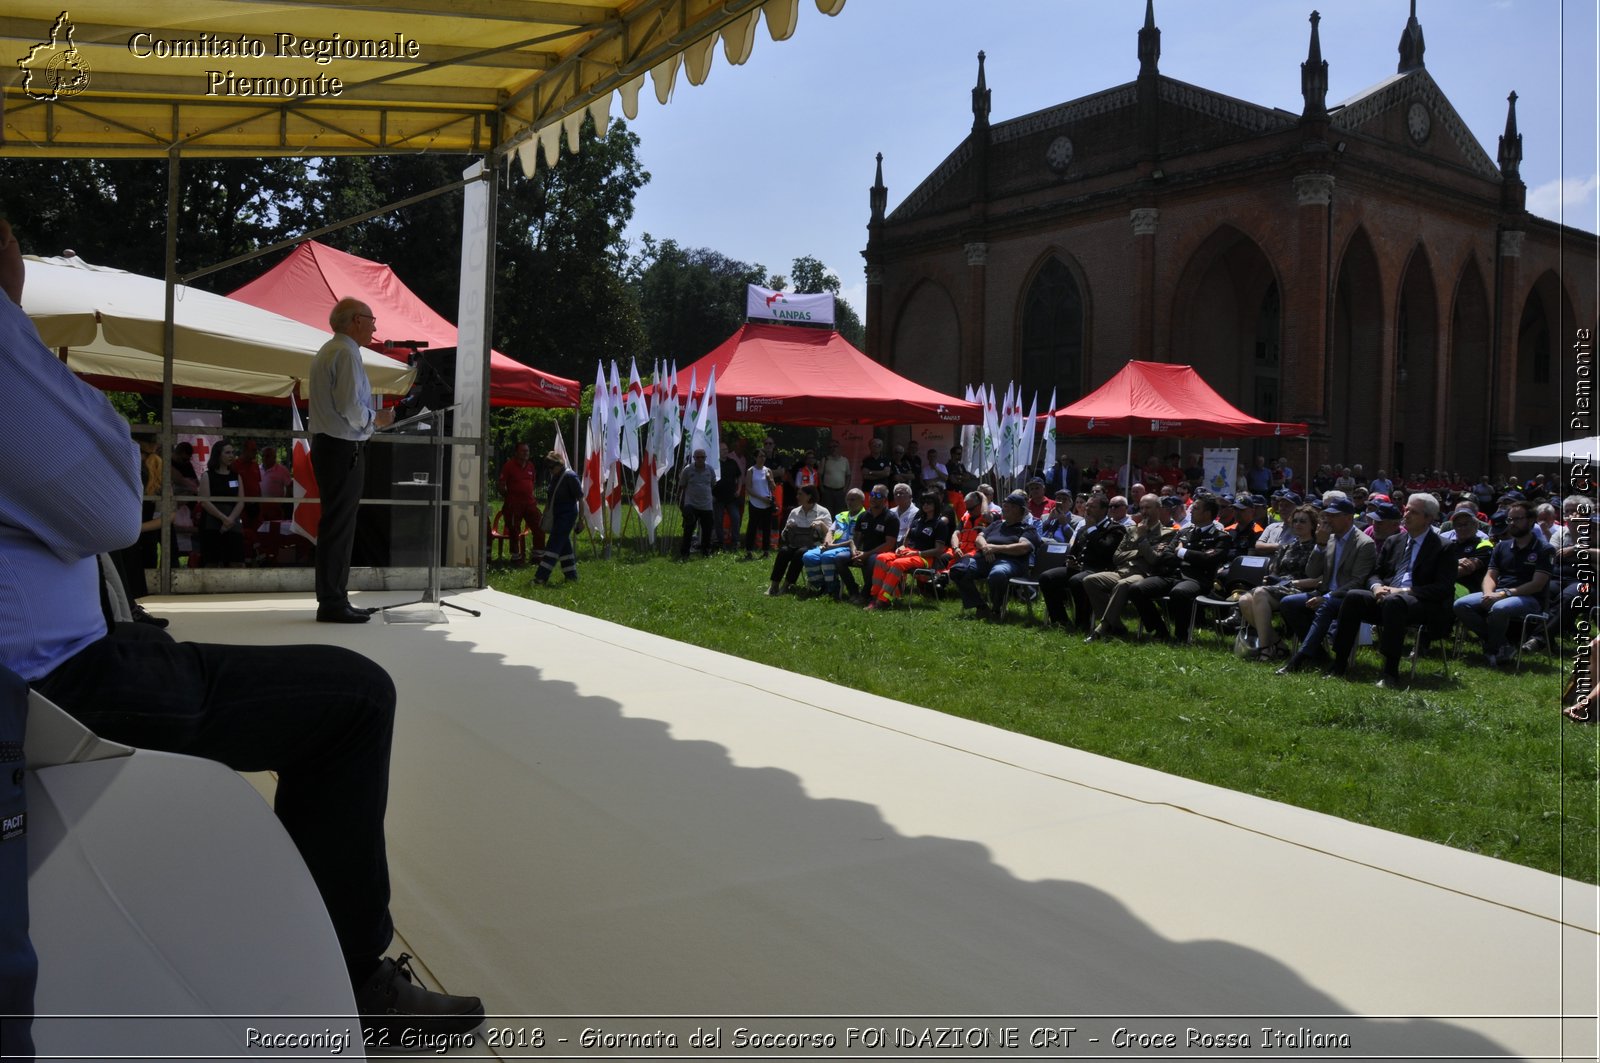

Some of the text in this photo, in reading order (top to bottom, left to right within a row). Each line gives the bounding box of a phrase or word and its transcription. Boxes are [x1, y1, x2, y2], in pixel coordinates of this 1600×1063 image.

[778, 310, 812, 321] ANPAS
[749, 405, 763, 413] CRT
[2, 814, 24, 831] FACIT
